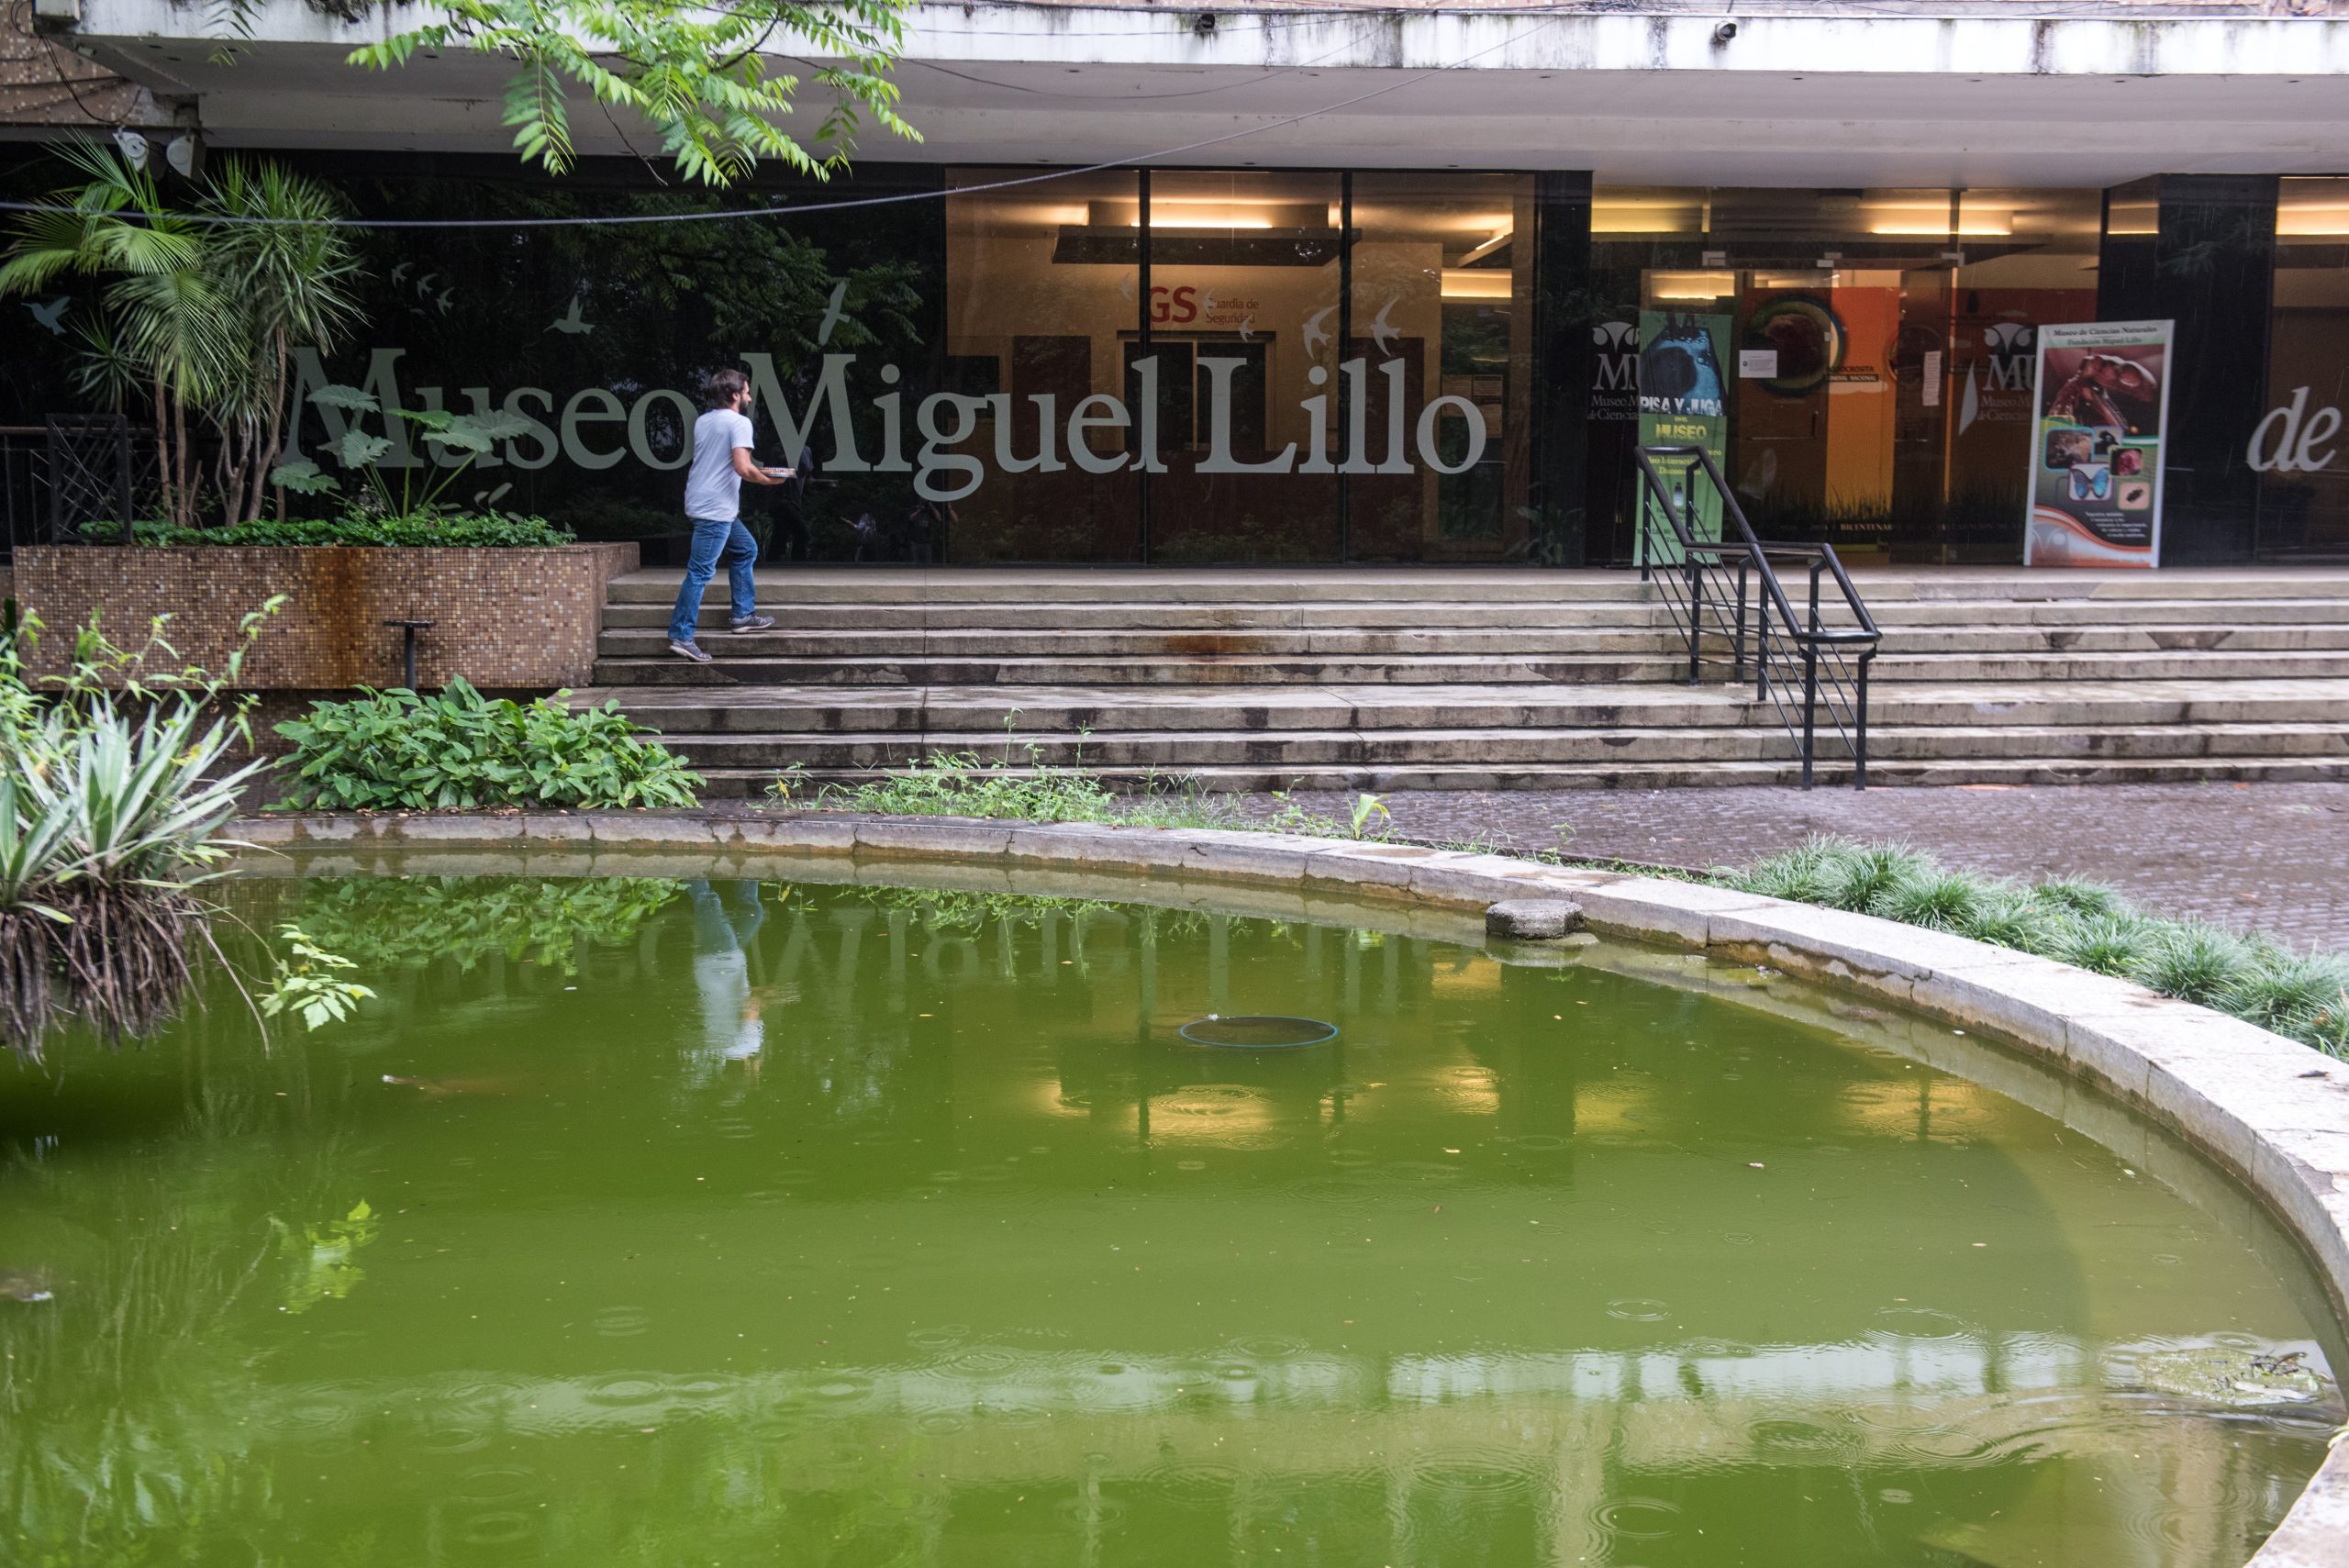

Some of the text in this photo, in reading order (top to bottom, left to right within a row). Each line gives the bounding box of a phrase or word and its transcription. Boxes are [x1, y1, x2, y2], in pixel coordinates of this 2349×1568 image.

[1150, 285, 1197, 323] GS
[1246, 299, 1260, 309] de
[1597, 408, 1640, 420] Ciencia
[1640, 396, 1672, 415] PISA
[1674, 397, 1685, 414] Y
[273, 346, 1487, 503] Museo Miguel Lillo
[1655, 424, 1708, 440] MUSEO
[2245, 385, 2343, 472] de
